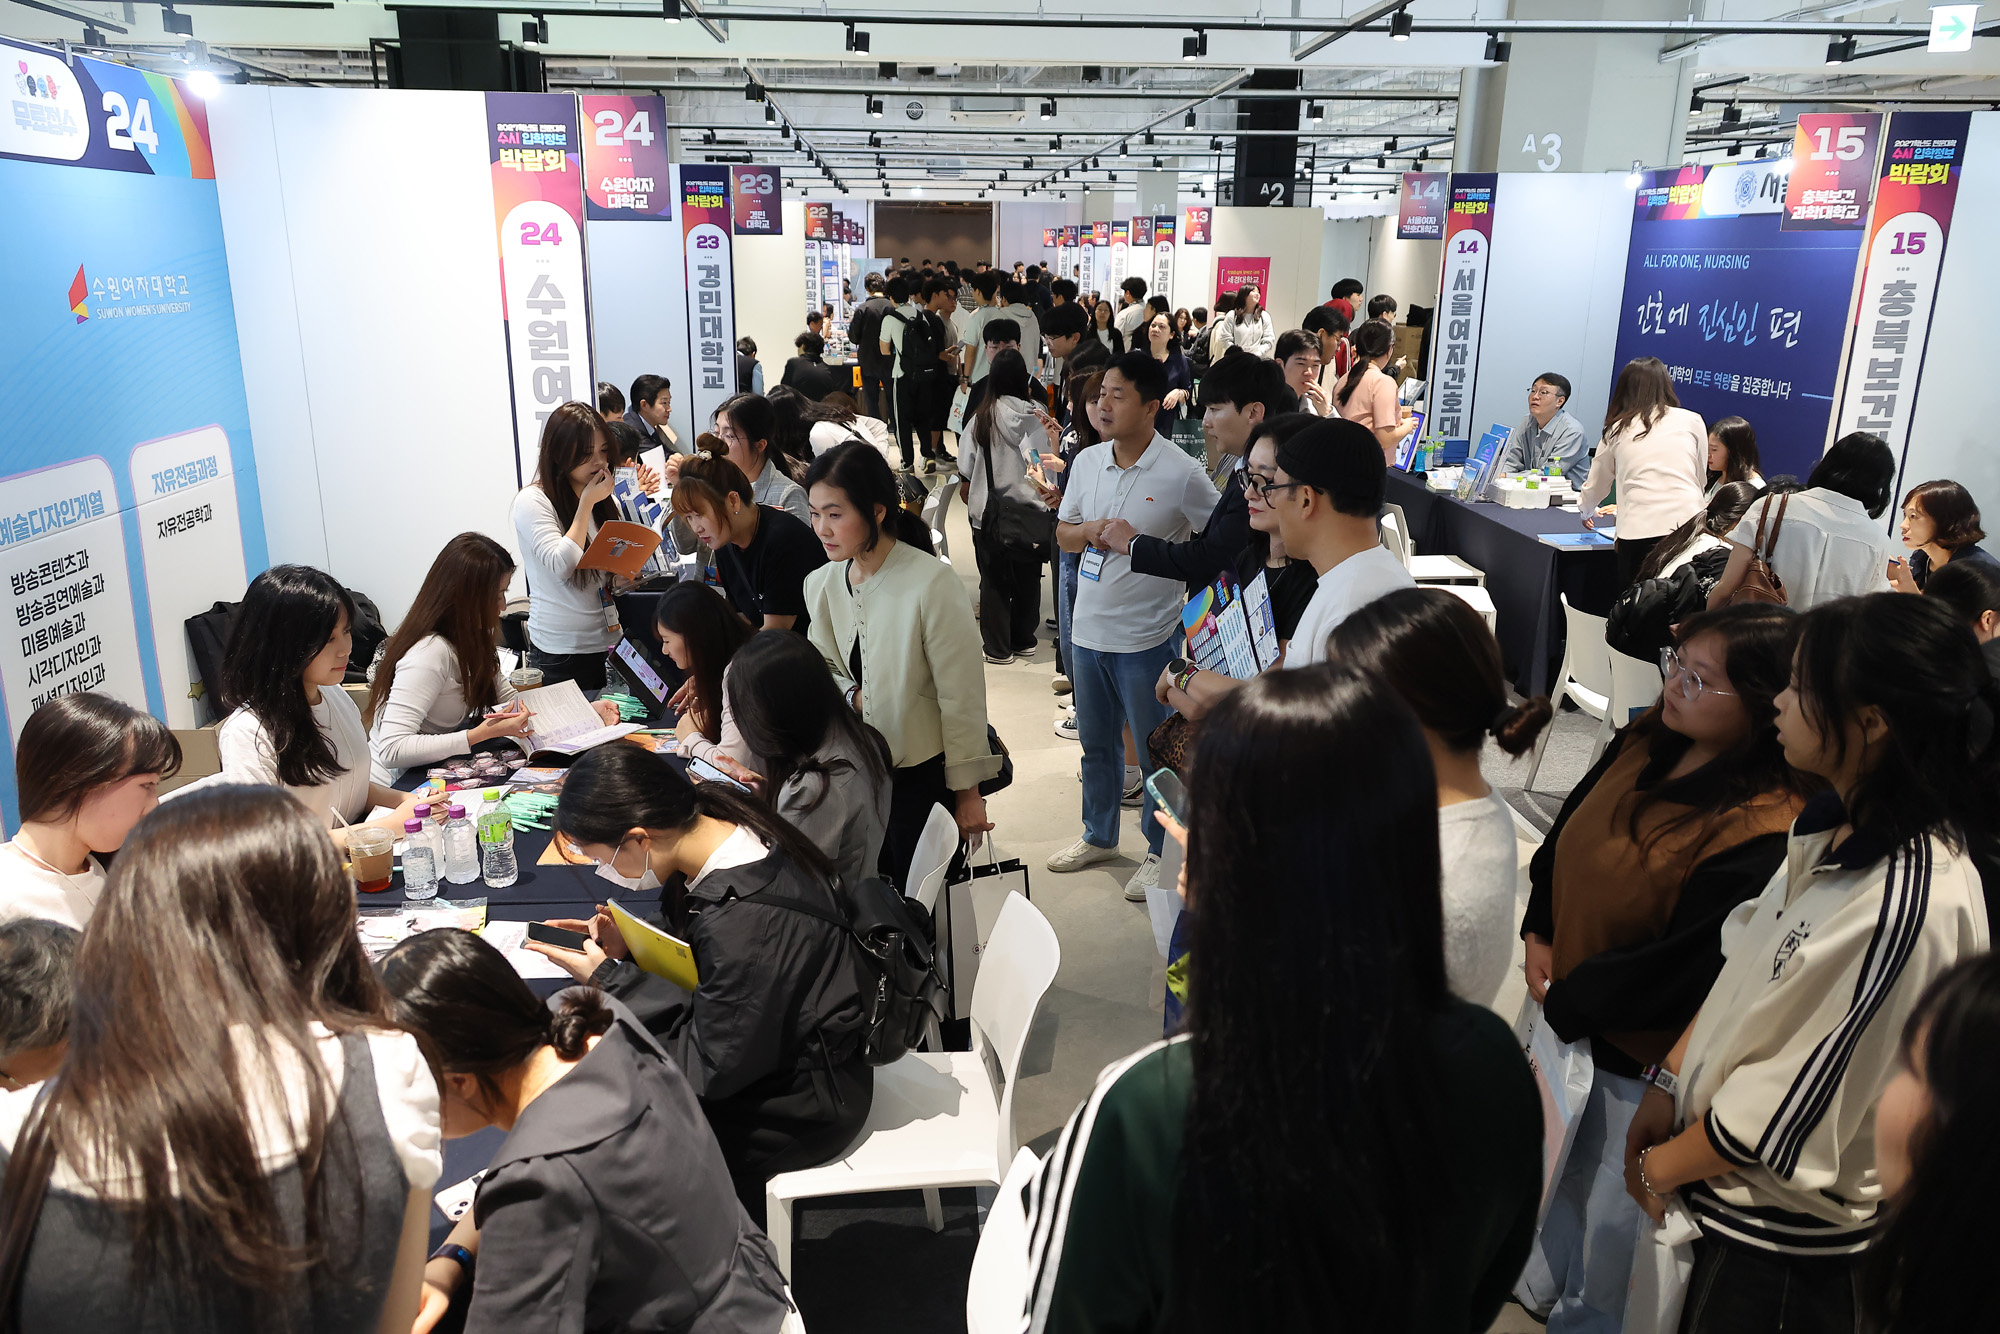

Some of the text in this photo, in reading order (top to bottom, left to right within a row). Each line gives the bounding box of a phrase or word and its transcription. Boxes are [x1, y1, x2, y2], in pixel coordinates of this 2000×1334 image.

[102, 91, 159, 154] 24
[593, 110, 655, 147] 24
[497, 131, 567, 146] 수시 입학정보
[1810, 126, 1867, 161] 15
[1894, 139, 1933, 147] 2027학년도
[499, 148, 567, 173] 박람회
[1521, 133, 1562, 172] A3
[1892, 148, 1956, 160] 수시 입학정보
[1889, 163, 1951, 185] 박람회
[600, 177, 655, 193] 수원여자
[739, 174, 774, 195] 23
[1260, 182, 1285, 205] A2
[1409, 180, 1440, 200] 14
[1669, 183, 1703, 206] 박람회
[607, 194, 649, 209] 대학교
[686, 195, 724, 208] 박람회
[1801, 189, 1857, 205] 충북보건
[749, 210, 766, 220] 경민
[809, 206, 829, 218] 22
[1191, 211, 1209, 223] 13
[1453, 201, 1489, 214] 박람회
[1790, 205, 1861, 221] 과학대학교
[745, 219, 771, 229] 대학교
[831, 214, 841, 224] 2
[843, 221, 849, 230] 1
[1096, 224, 1109, 232] 12
[1136, 219, 1151, 229] 13
[1406, 216, 1437, 225] 서울여자
[520, 222, 562, 245] 24
[1066, 227, 1076, 235] 11
[1402, 225, 1439, 234] 간호대학교
[696, 235, 720, 249] 23
[1457, 240, 1479, 254] 14
[1890, 232, 1927, 255] 15
[1643, 254, 1751, 271] ALL FOR ONE, NURSING
[1157, 259, 1169, 297] 세경대
[1227, 275, 1259, 284] 세경대학교
[92, 275, 190, 302] 수원여자대학교
[97, 301, 192, 320] SUWON WOMEN'S UNIVERSITY
[1637, 290, 1802, 348] 간호에 진심인 편
[698, 264, 725, 389] 경민대학교
[1439, 268, 1476, 437] 서울여자간호대
[1856, 279, 1917, 444] 충북보건
[1668, 365, 1792, 400] 대학의 모든 역량을 집중합니다
[151, 455, 219, 496] 자유전공과정
[0, 489, 105, 546] 예술디자인계열
[157, 503, 213, 540] 자유전공학과
[10, 549, 90, 597] 방송콘텐츠과
[15, 572, 105, 627] 방송공연예술과
[21, 612, 86, 658] 미용예술과
[28, 634, 102, 688] 시각디자인과
